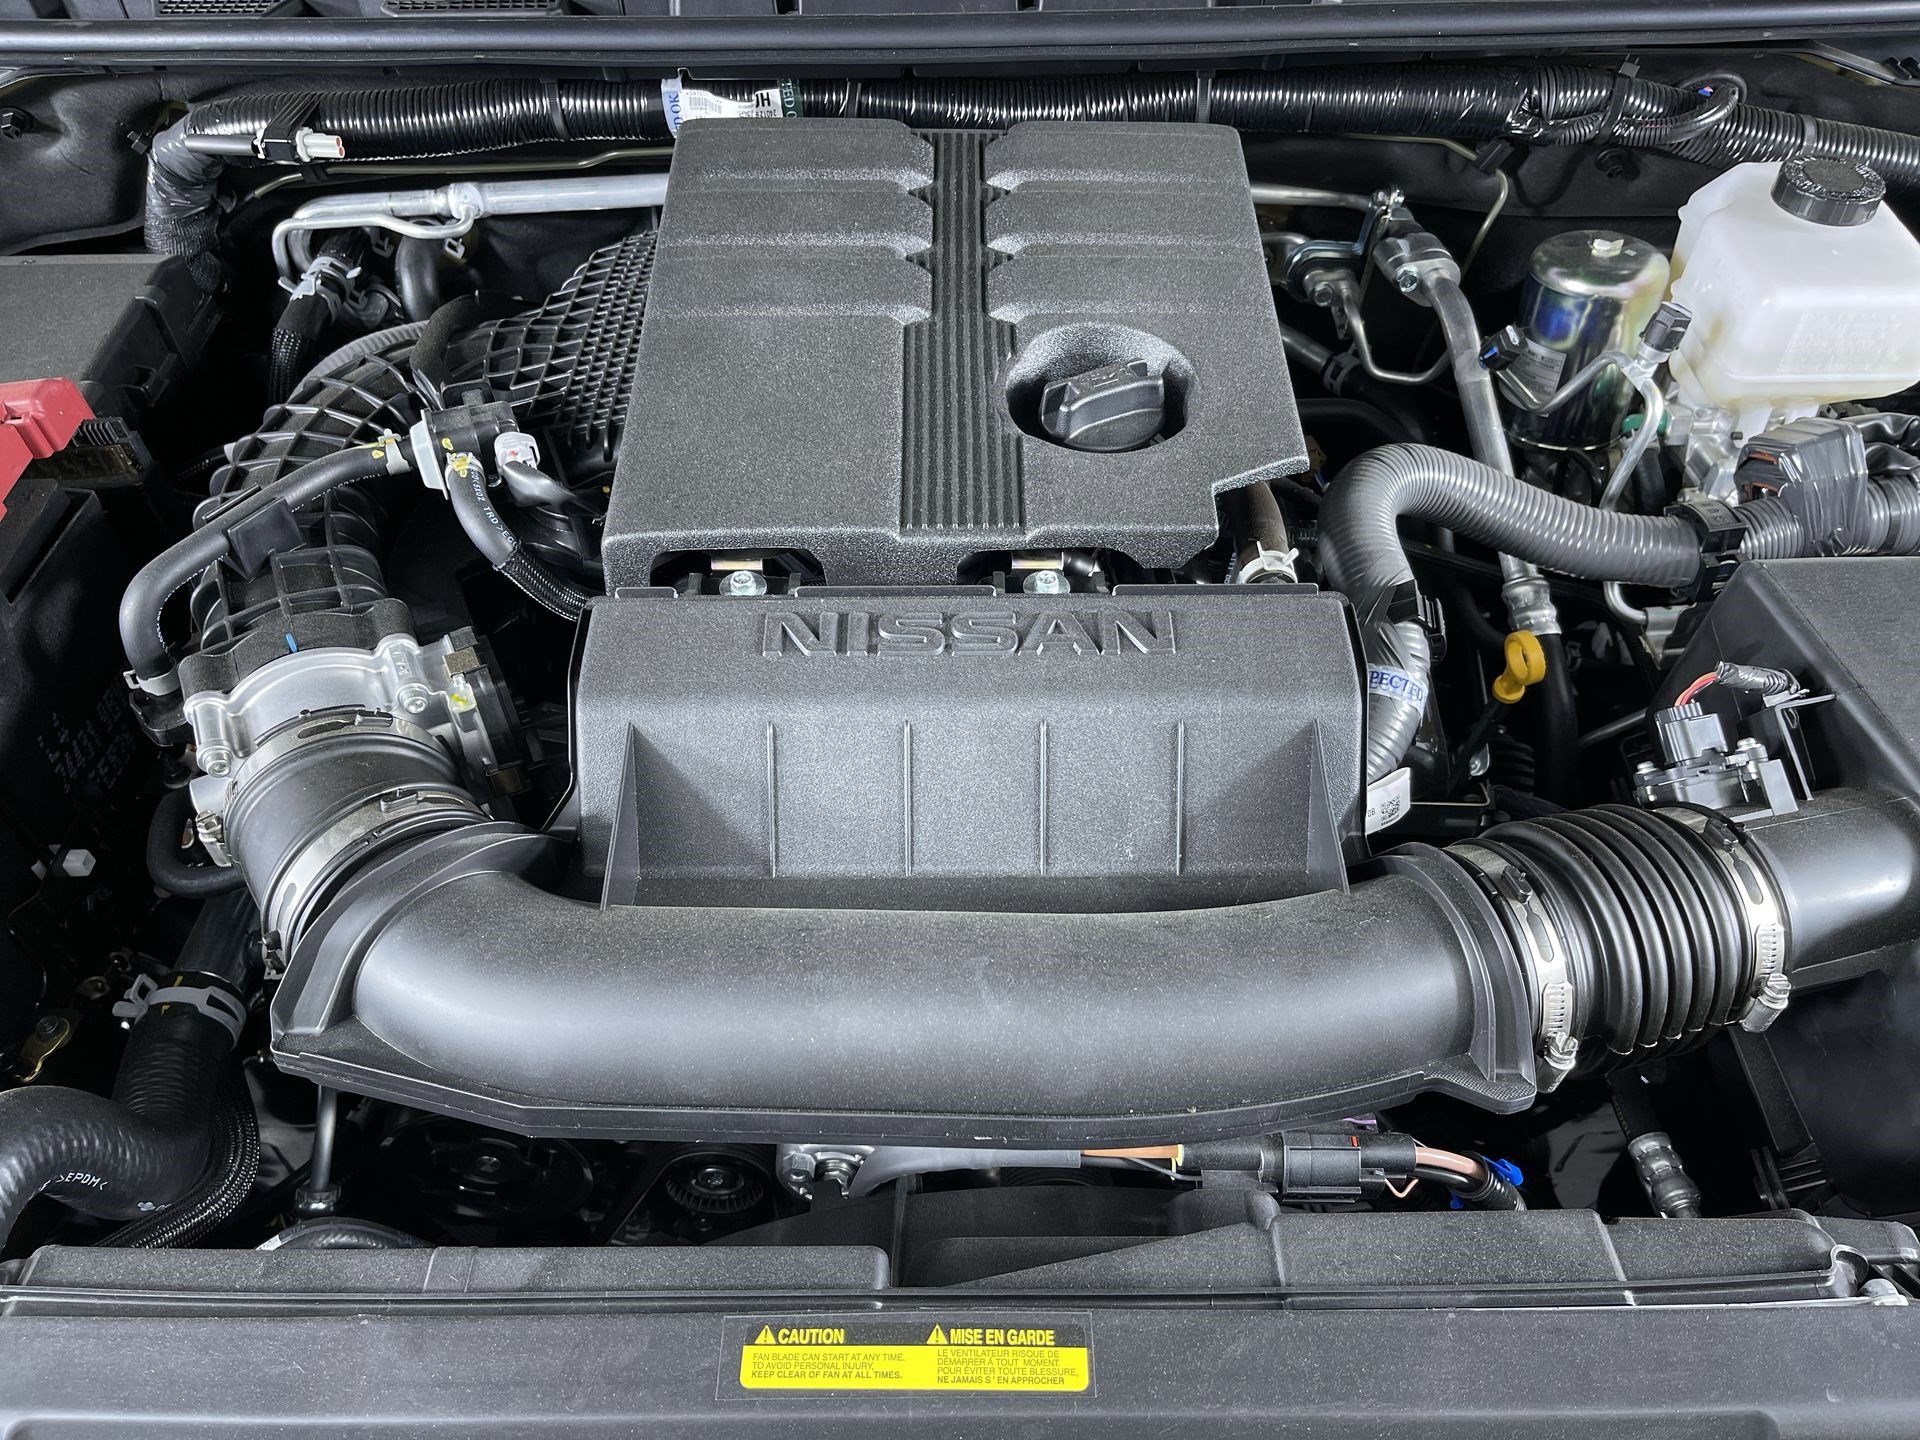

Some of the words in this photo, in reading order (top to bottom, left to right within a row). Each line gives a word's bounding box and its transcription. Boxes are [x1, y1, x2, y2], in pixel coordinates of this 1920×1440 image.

[669, 93, 681, 113] OK
[483, 506, 499, 525] TRD
[762, 610, 1177, 657] NISSAN
[777, 1328, 845, 1345] CAUTION
[950, 1328, 983, 1345] MISE
[985, 1328, 1004, 1345] EN
[1007, 1328, 1055, 1346] GARDE
[753, 1353, 770, 1361] FAN
[771, 1353, 800, 1361] BLADE
[802, 1353, 821, 1361] CAN
[822, 1353, 850, 1361] START
[850, 1353, 863, 1361] AT
[863, 1353, 881, 1361] ANY
[937, 1349, 949, 1358] LE
[950, 1349, 1010, 1358] VENTILATEUR
[1012, 1350, 1046, 1358] RISQUE
[1047, 1350, 1060, 1359] DE
[752, 1362, 764, 1370] TO
[766, 1362, 792, 1370] AVOID
[793, 1362, 841, 1370] PERSONAL
[996, 1358, 1019, 1367] TOUT
[751, 1371, 774, 1379] KEEP
[776, 1371, 806, 1379] CLEAR
[808, 1371, 821, 1379] OF
[822, 1371, 841, 1379] FAN
[841, 1371, 854, 1379] AT
[854, 1371, 871, 1379] ALL
[873, 1371, 903, 1379] TIMES.
[937, 1366, 962, 1375] POUR
[997, 1367, 1028, 1375] TOUTE
[937, 1375, 949, 1384] NE
[950, 1375, 983, 1384] JAMAIS
[1010, 1376, 1065, 1385] APPROCHER
